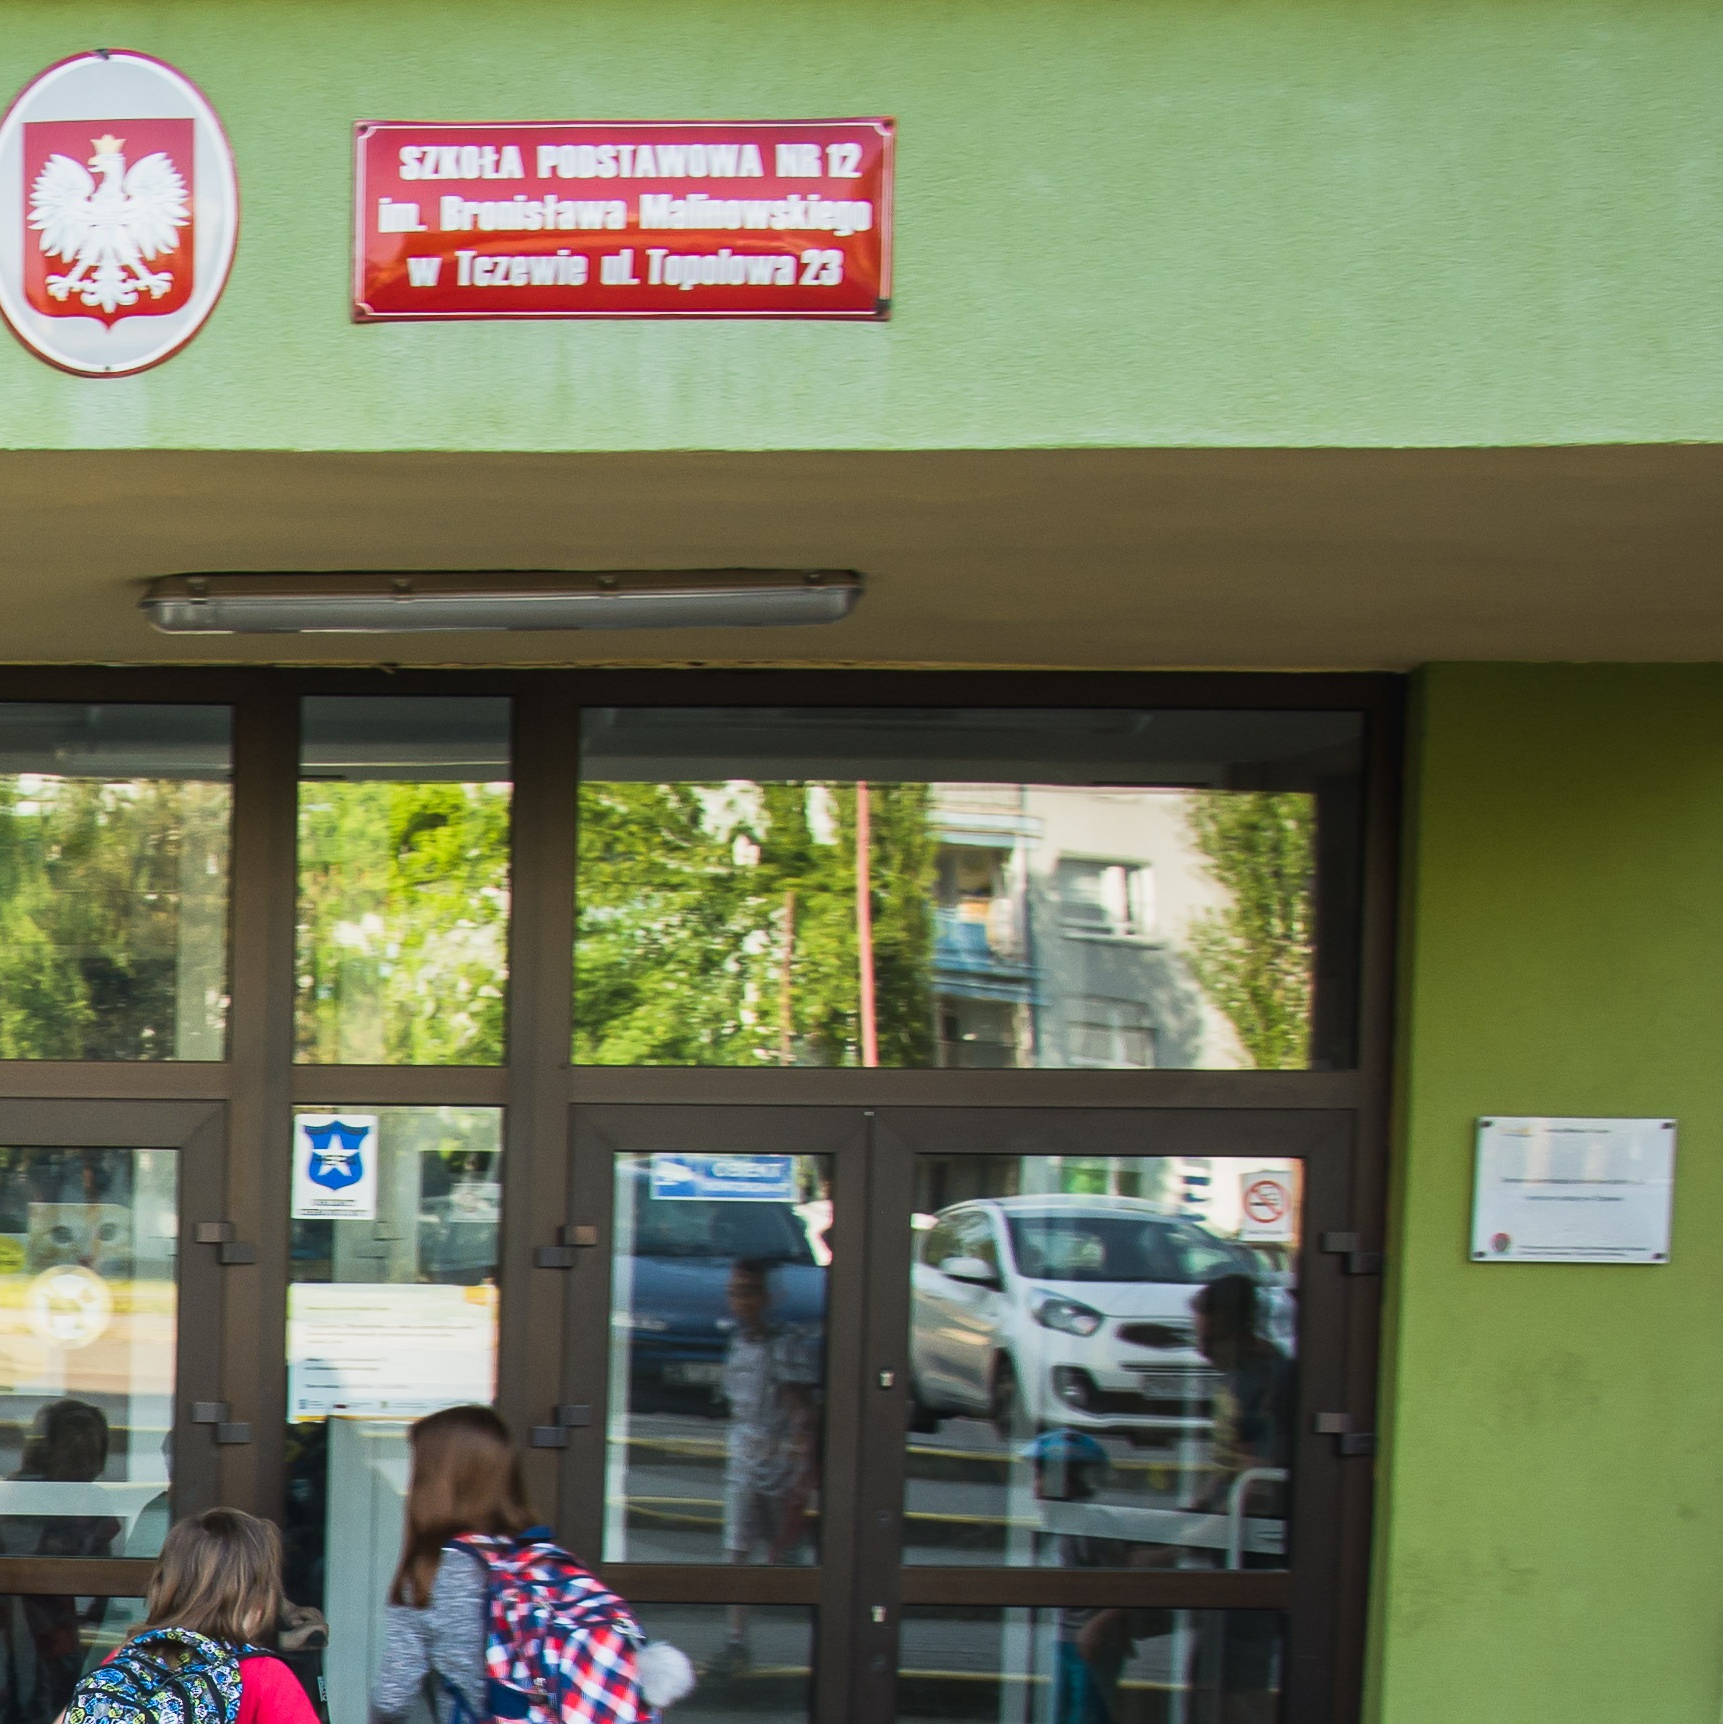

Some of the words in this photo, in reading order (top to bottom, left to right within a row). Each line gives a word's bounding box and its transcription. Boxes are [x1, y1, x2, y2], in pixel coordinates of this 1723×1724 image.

[399, 145, 525, 180] SZKOŁA
[536, 143, 765, 179] PODSTAWOWA
[775, 143, 823, 178] NR
[825, 142, 863, 178] 12
[378, 197, 428, 233] im.
[440, 194, 627, 231] Bronisława
[639, 193, 873, 237] Malinowskiego
[406, 256, 443, 287] w
[454, 249, 589, 286] Tczewie
[600, 248, 641, 285] ul.
[646, 248, 797, 290] Topolowa
[799, 248, 845, 286] 23
